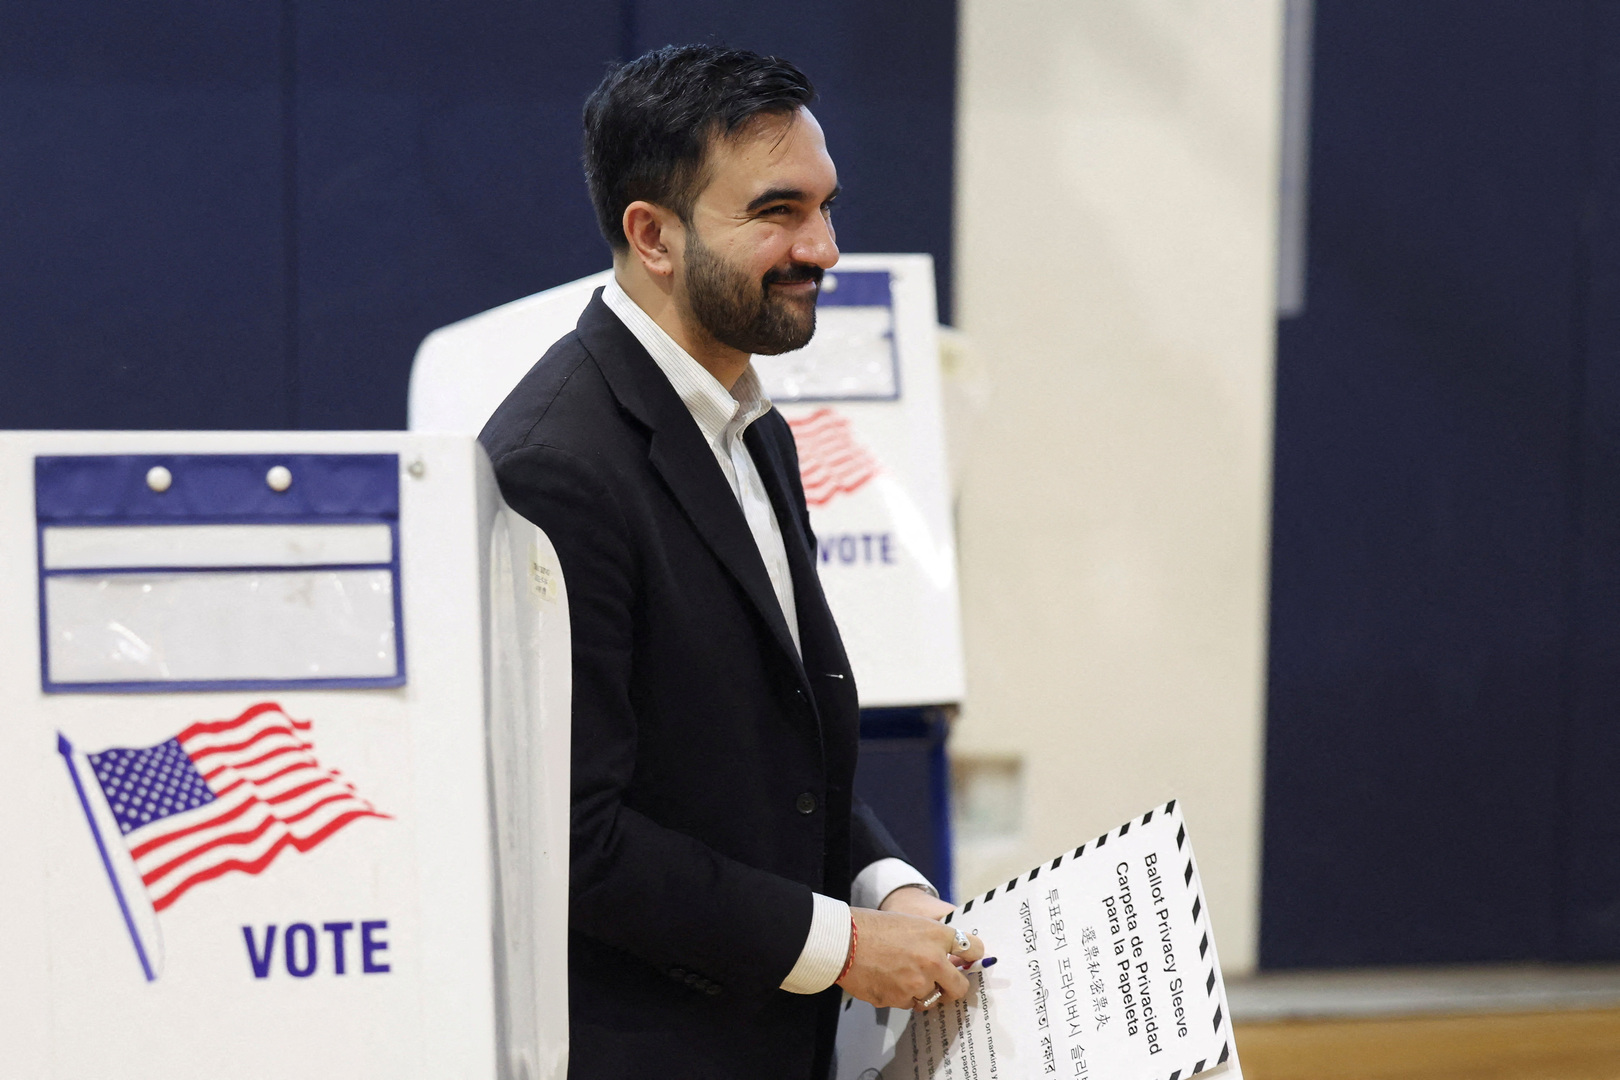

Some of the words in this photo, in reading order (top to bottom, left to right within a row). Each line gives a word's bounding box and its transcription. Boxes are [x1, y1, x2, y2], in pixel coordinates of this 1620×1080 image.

[817, 532, 898, 565] VOTE
[1102, 895, 1120, 935] para
[1116, 861, 1138, 932] Carpeta
[242, 921, 391, 978] VOTE
[1113, 938, 1125, 956] la
[1130, 935, 1144, 958] de
[1144, 852, 1165, 906] Ballot
[1156, 908, 1177, 973] Privacy
[1169, 977, 1188, 1038] Sleeve
[978, 971, 990, 1021] nstructions
[1045, 889, 1068, 951] 투표용지
[1058, 957, 1082, 1038] 프라이버시
[1070, 1044, 1089, 1080] 슬리
[1081, 926, 1111, 1032] 選票私密票夾
[1117, 959, 1139, 1036] Papeleta
[955, 1009, 965, 1040] marcar
[960, 1041, 966, 1053] su
[985, 1022, 992, 1035] on
[1135, 961, 1162, 1055] Privacidad
[987, 1036, 998, 1074] marking
